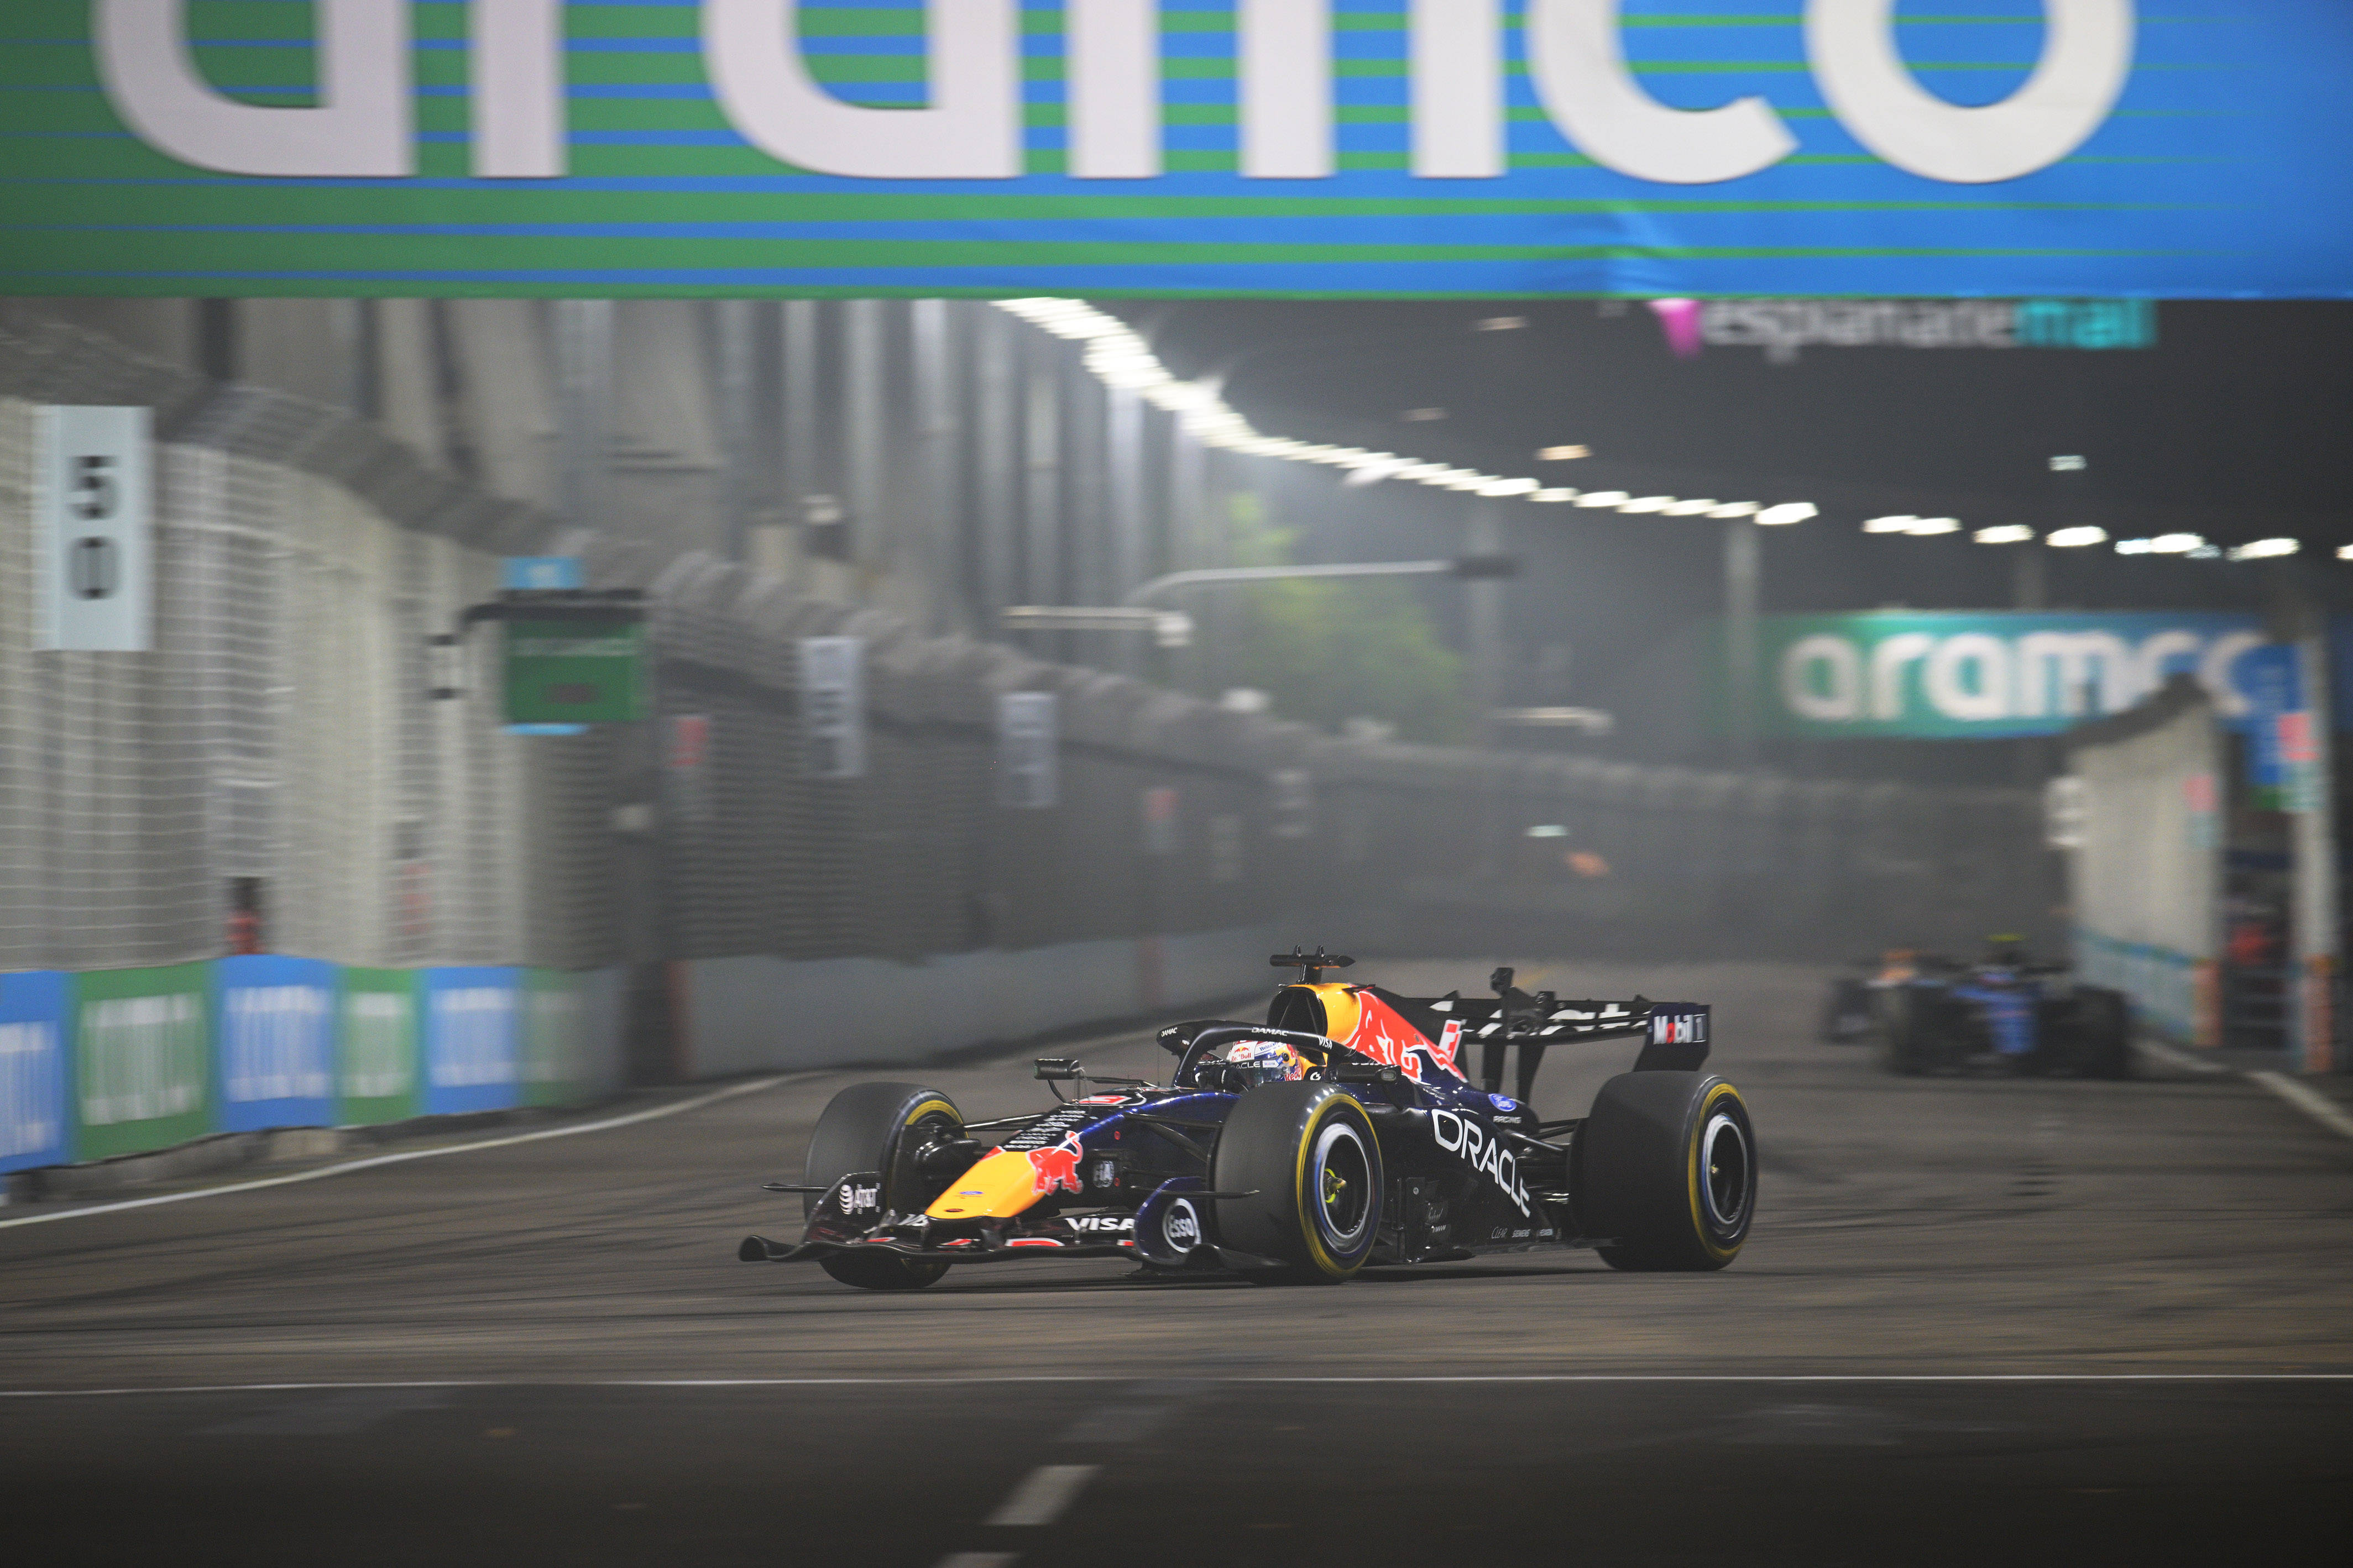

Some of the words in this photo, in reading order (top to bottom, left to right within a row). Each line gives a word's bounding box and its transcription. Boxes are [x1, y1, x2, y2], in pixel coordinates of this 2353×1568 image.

[1251, 1027, 1289, 1037] DAMAC
[1318, 1036, 1333, 1050] VISA
[1431, 1109, 1531, 1218] ORACLE
[1064, 1218, 1135, 1231] VISA
